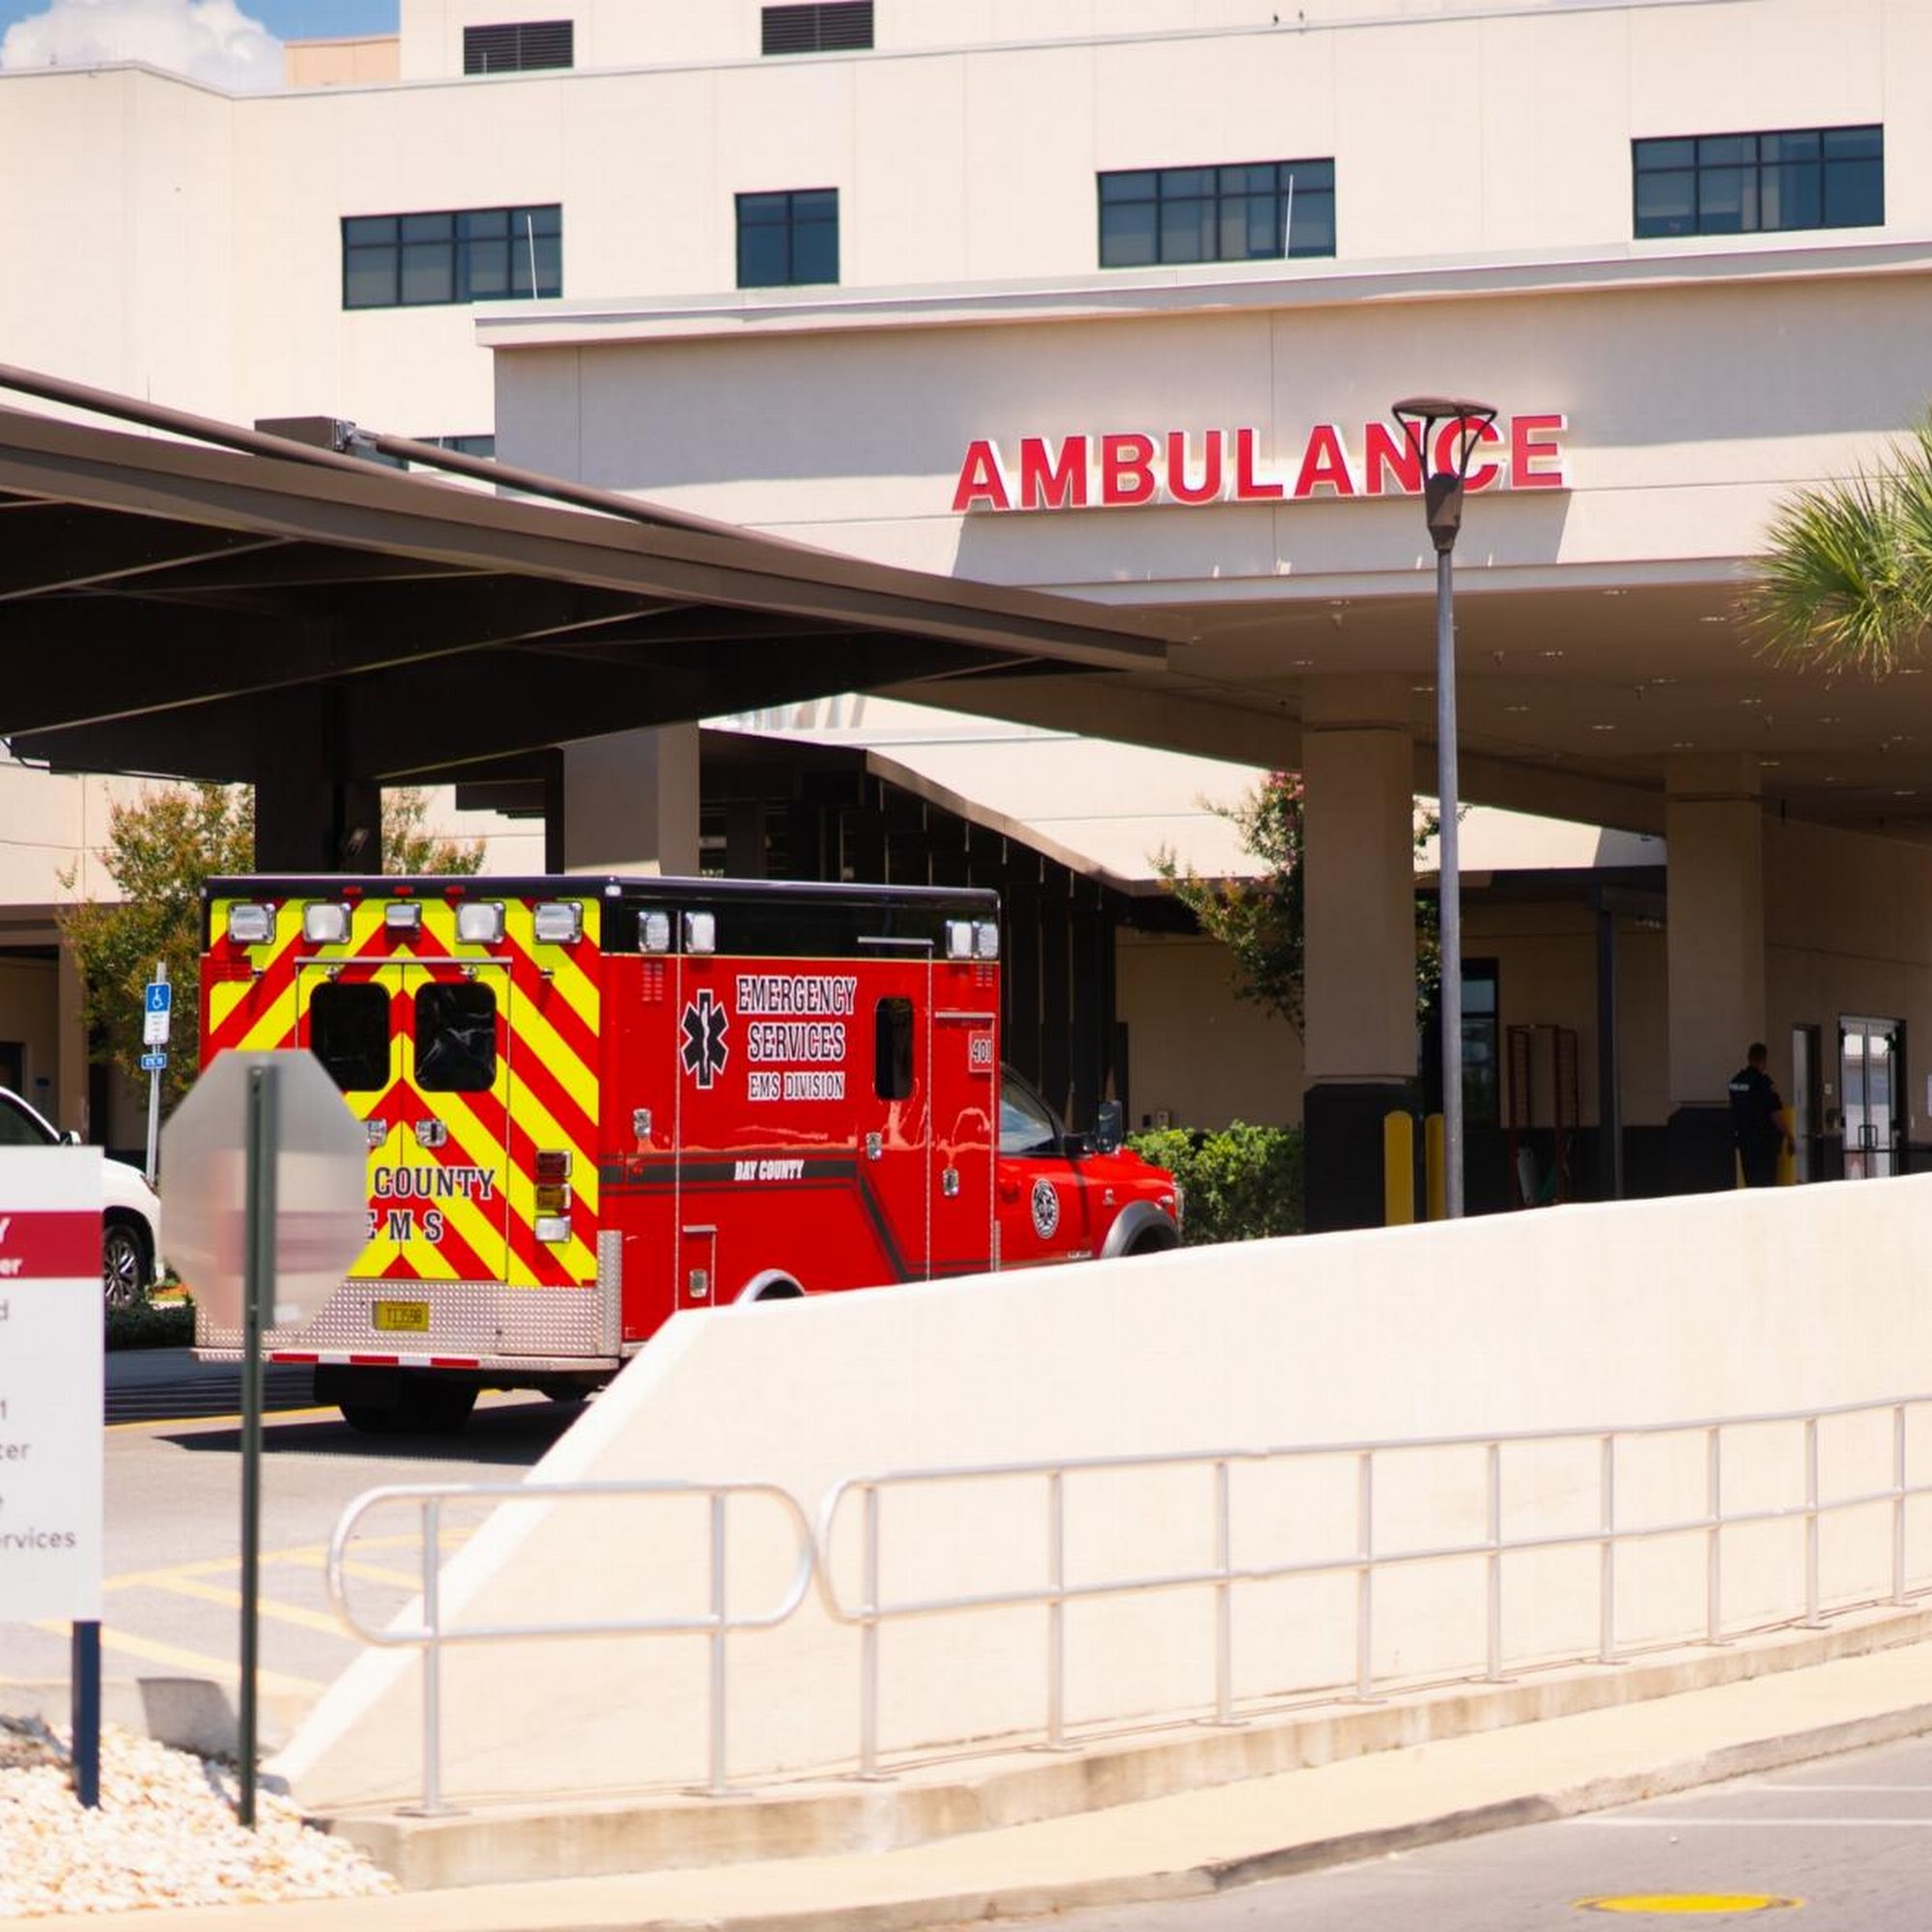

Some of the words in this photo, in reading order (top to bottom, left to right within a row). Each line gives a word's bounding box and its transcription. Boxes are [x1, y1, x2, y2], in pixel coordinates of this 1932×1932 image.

[952, 413, 1568, 513] AMBULANCE
[736, 975, 857, 1015] EMERGENCY
[748, 1022, 846, 1062] SERVICES
[748, 1072, 781, 1101] EMS
[783, 1071, 845, 1100] DIVISION
[373, 1166, 497, 1200] COUNTY
[734, 1160, 758, 1180] BAY
[758, 1159, 805, 1180] COUNTY
[0, 1526, 76, 1549] rvices
